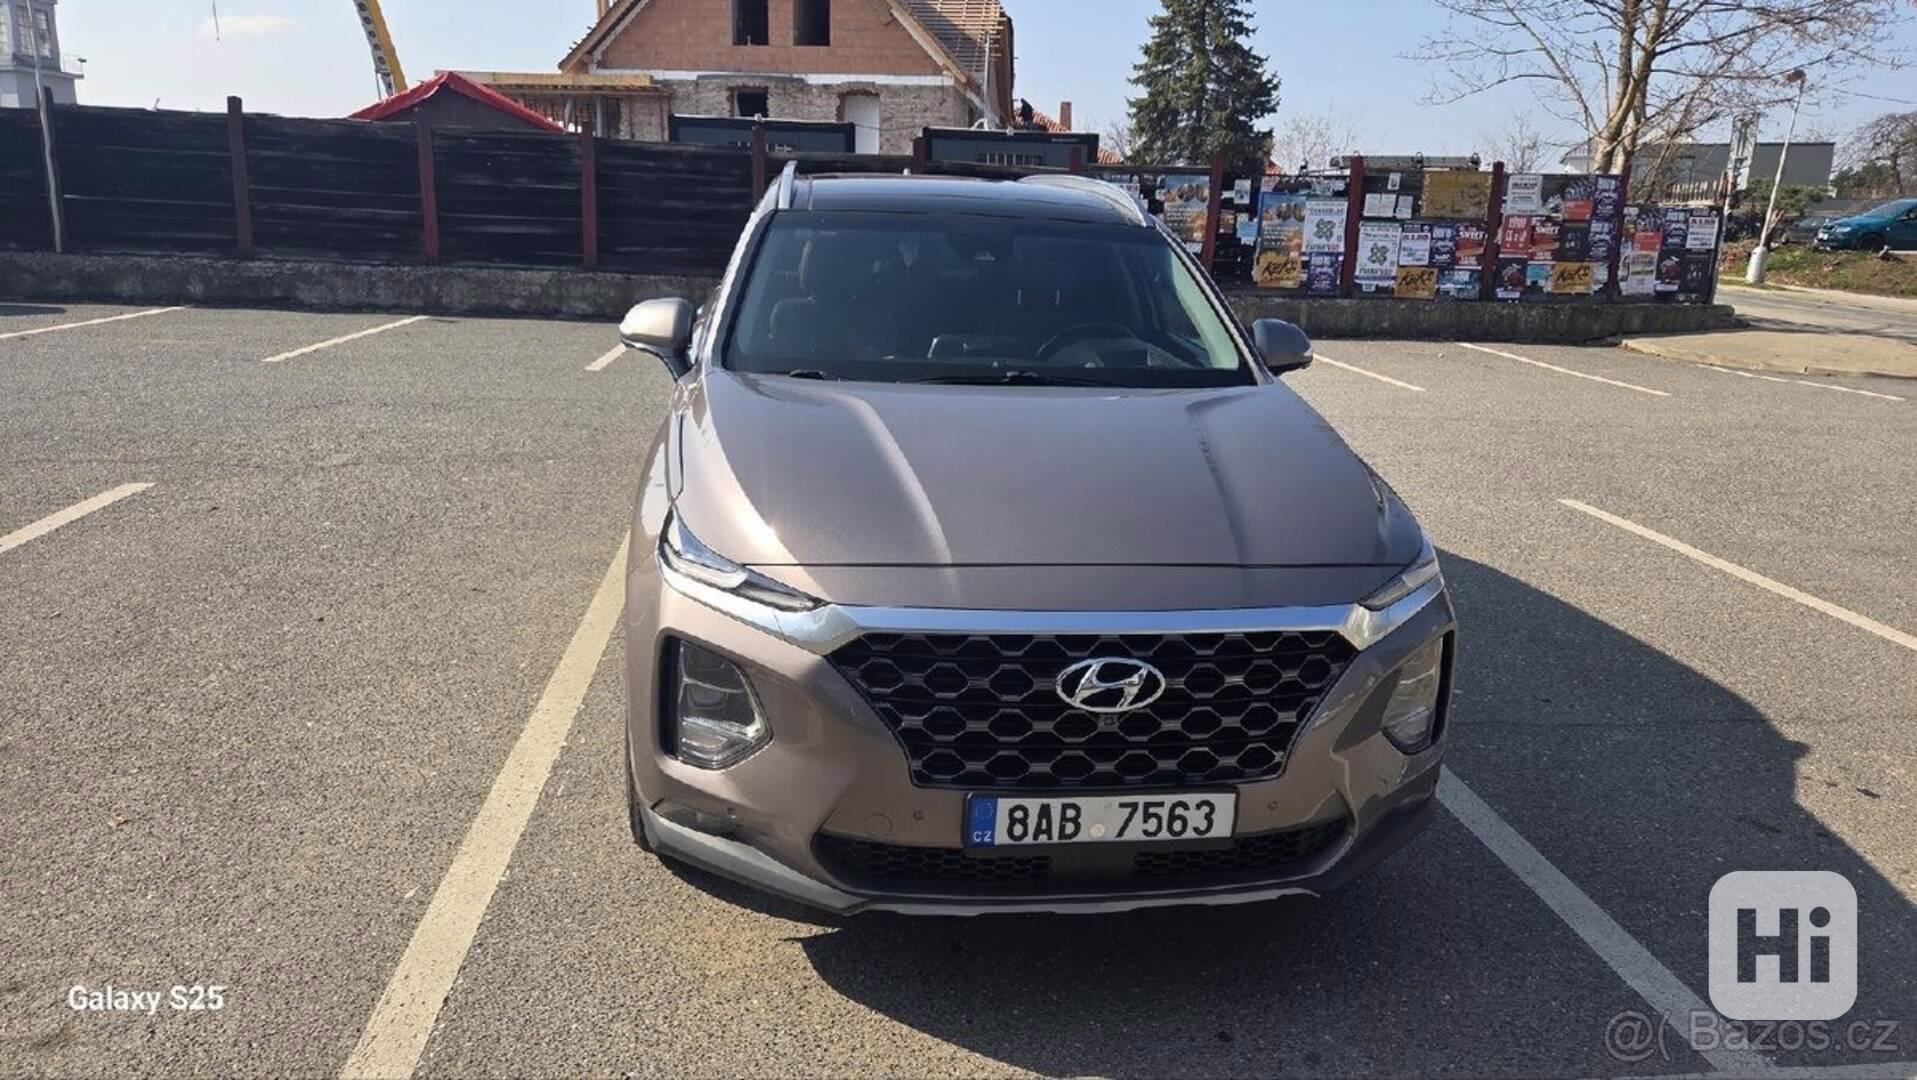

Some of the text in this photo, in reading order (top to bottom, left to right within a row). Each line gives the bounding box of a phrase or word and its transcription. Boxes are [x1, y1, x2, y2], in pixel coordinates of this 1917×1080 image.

[1006, 800, 1216, 843] 8AB 7563
[973, 831, 992, 843] CZ
